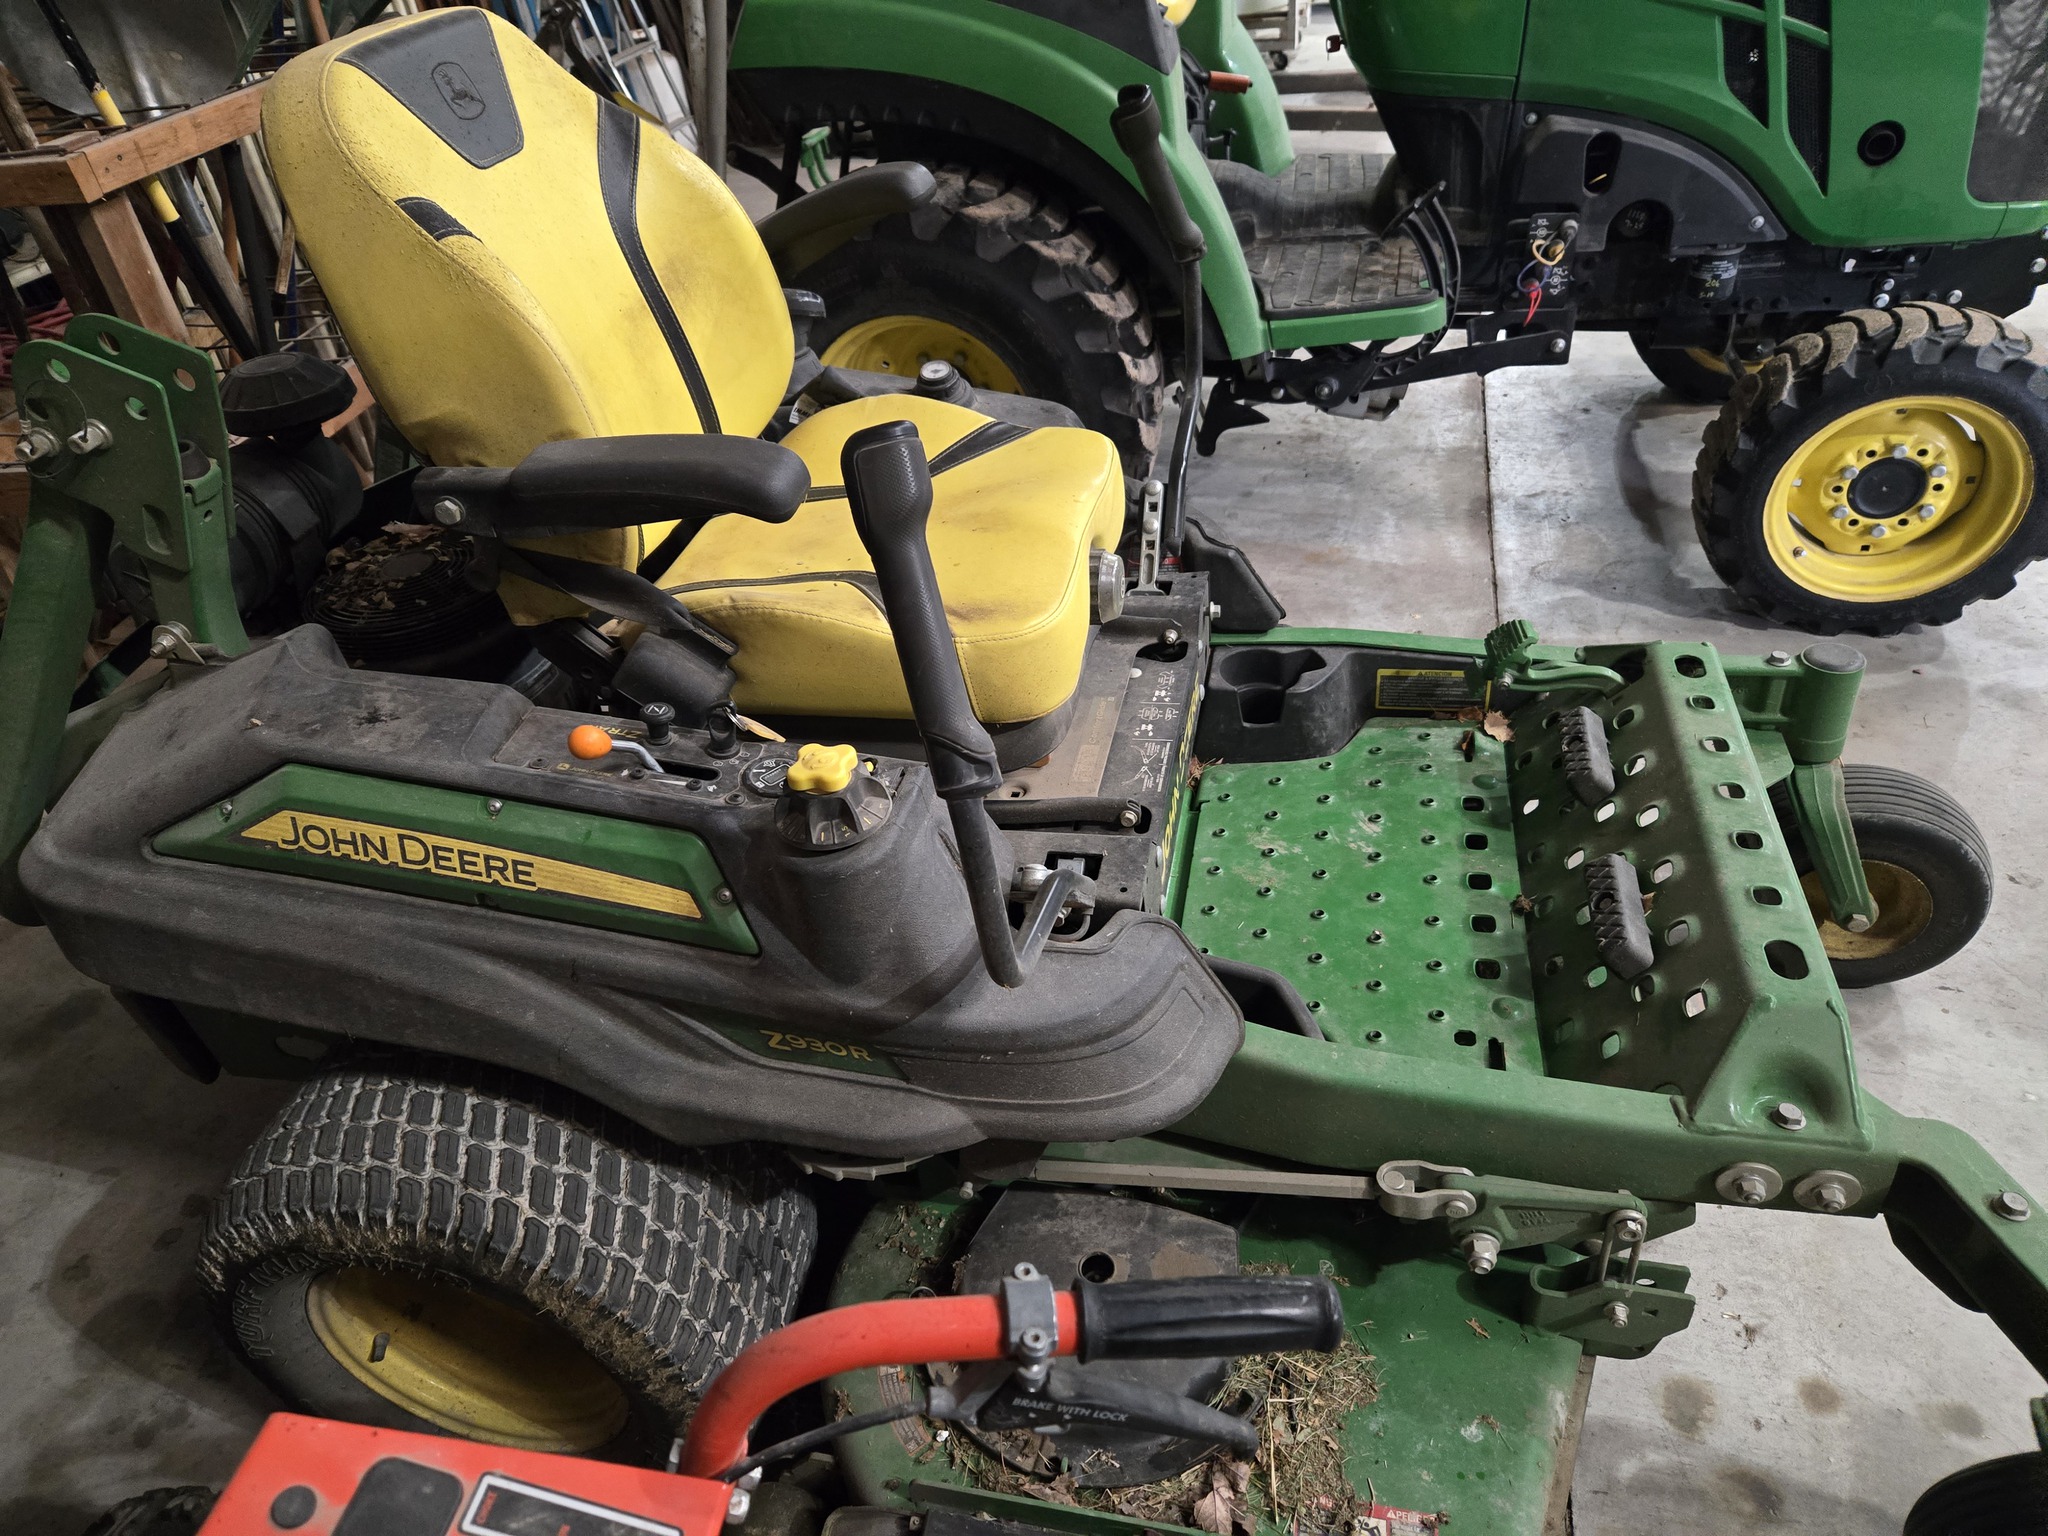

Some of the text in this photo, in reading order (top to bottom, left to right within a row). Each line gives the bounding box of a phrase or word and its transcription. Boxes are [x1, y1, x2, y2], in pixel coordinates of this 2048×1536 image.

[593, 725, 642, 739] ZTRA
[281, 816, 538, 888] JOHN DEERE
[759, 1029, 873, 1062] Z930R
[1012, 1397, 1129, 1422] BRAKE WITH LOCK
